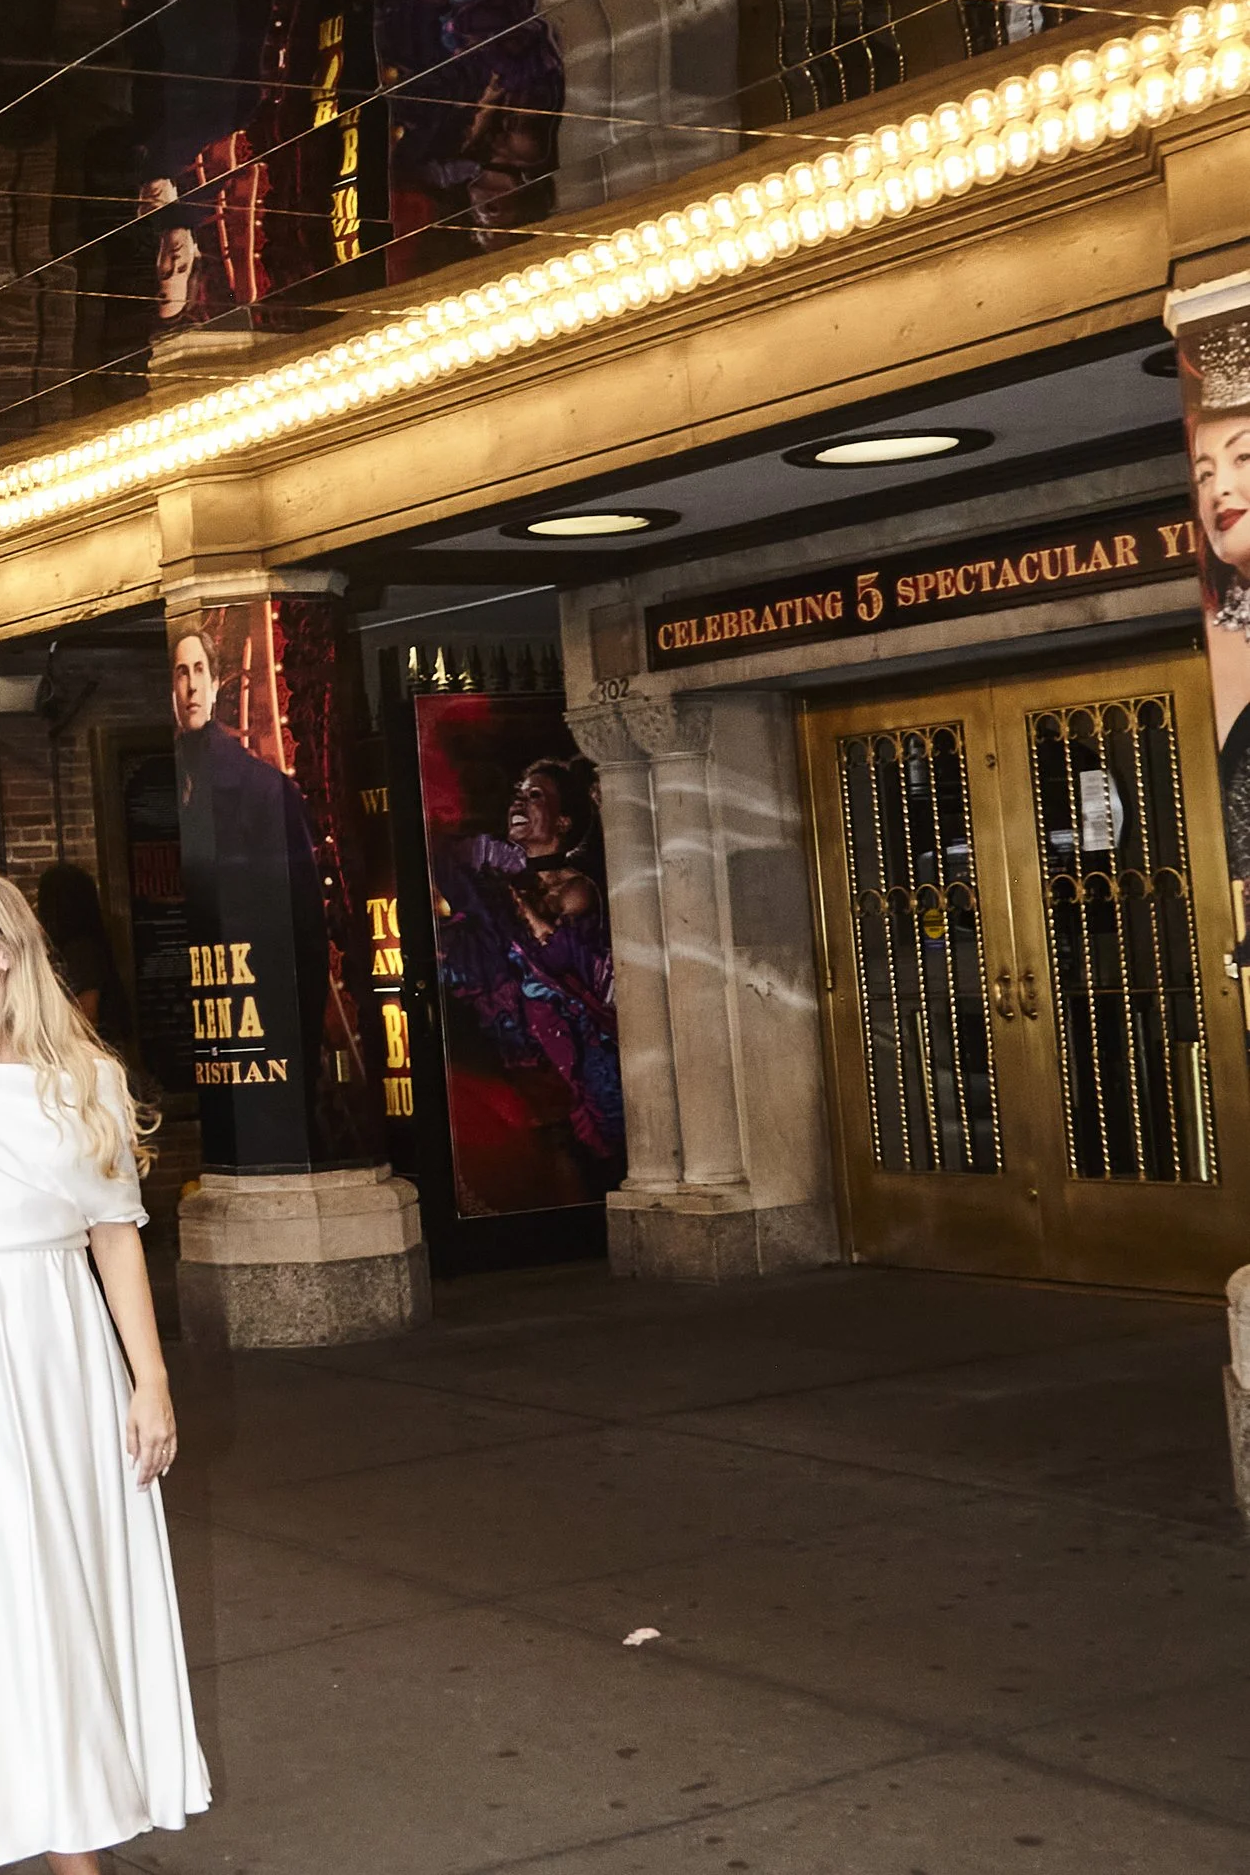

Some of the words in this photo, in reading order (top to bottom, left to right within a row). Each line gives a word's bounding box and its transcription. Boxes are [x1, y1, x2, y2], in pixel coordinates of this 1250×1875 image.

[657, 590, 843, 651] CELEBRATING
[855, 572, 884, 621] 5
[897, 534, 1138, 608] SPECTACULAR
